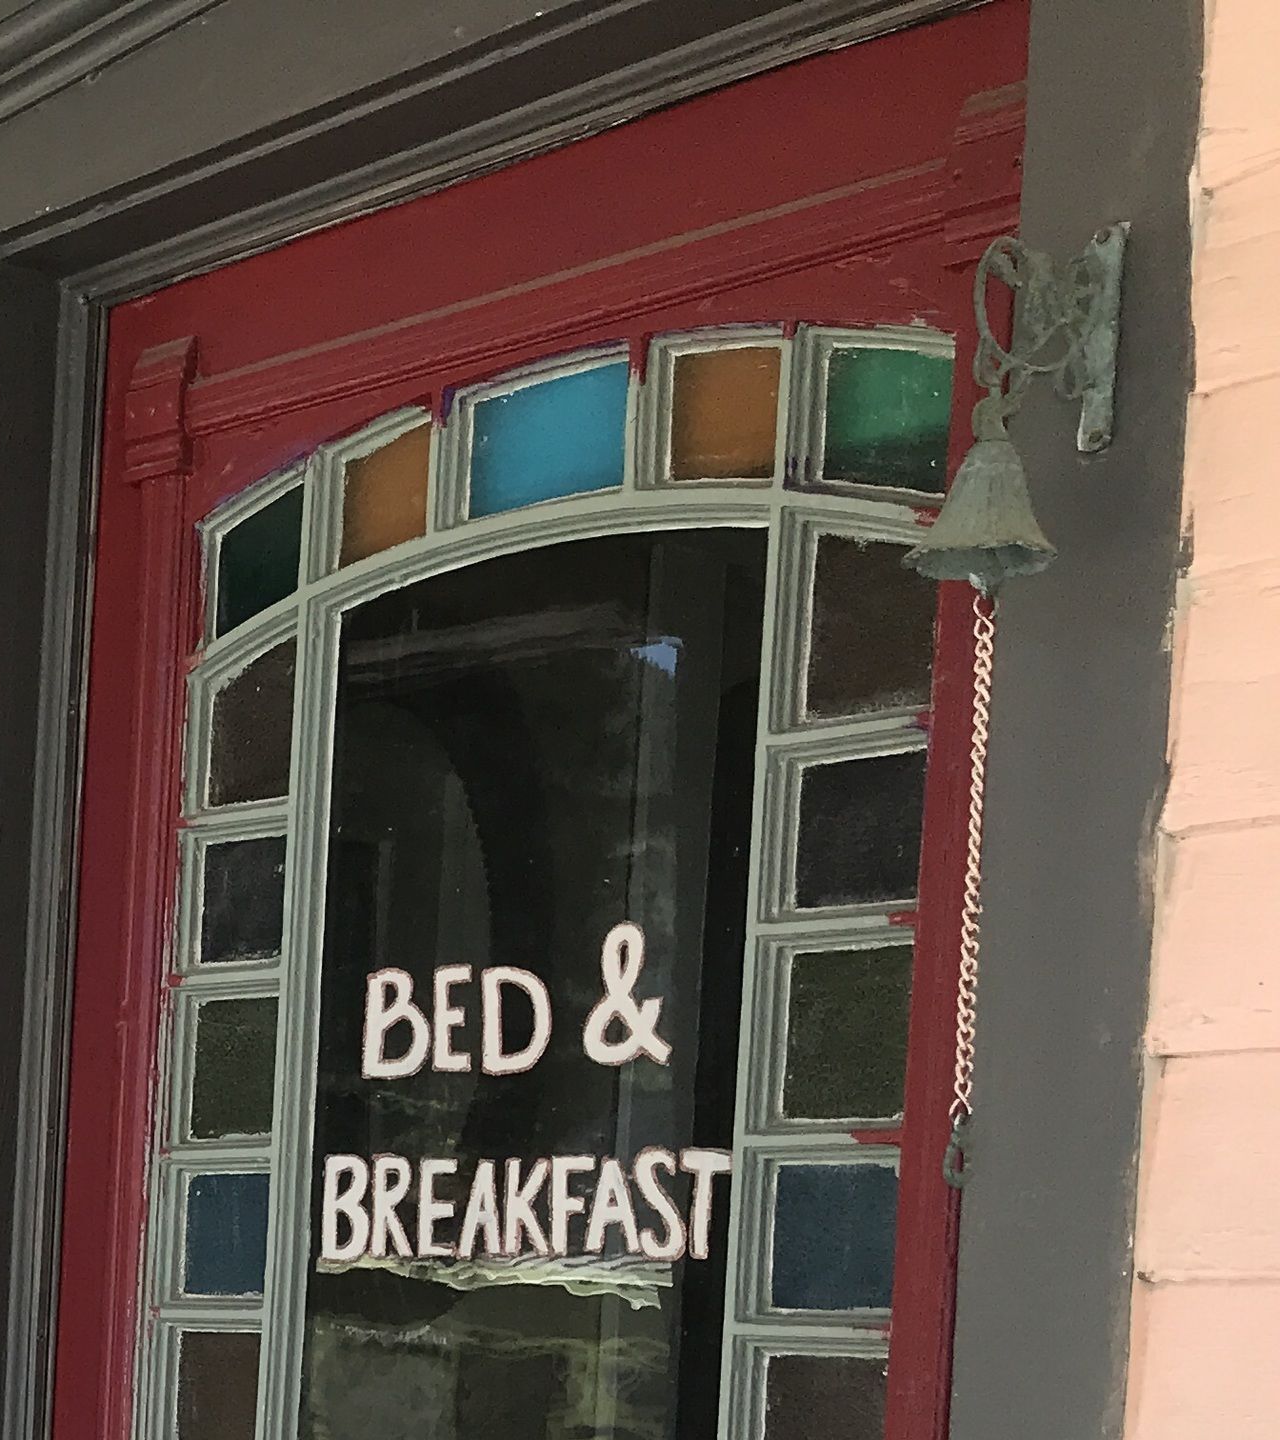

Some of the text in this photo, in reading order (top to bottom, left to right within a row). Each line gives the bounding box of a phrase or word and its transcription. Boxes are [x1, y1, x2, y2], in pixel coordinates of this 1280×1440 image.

[361, 920, 673, 1080] BED &
[321, 1145, 733, 1263] BREAKFAST
